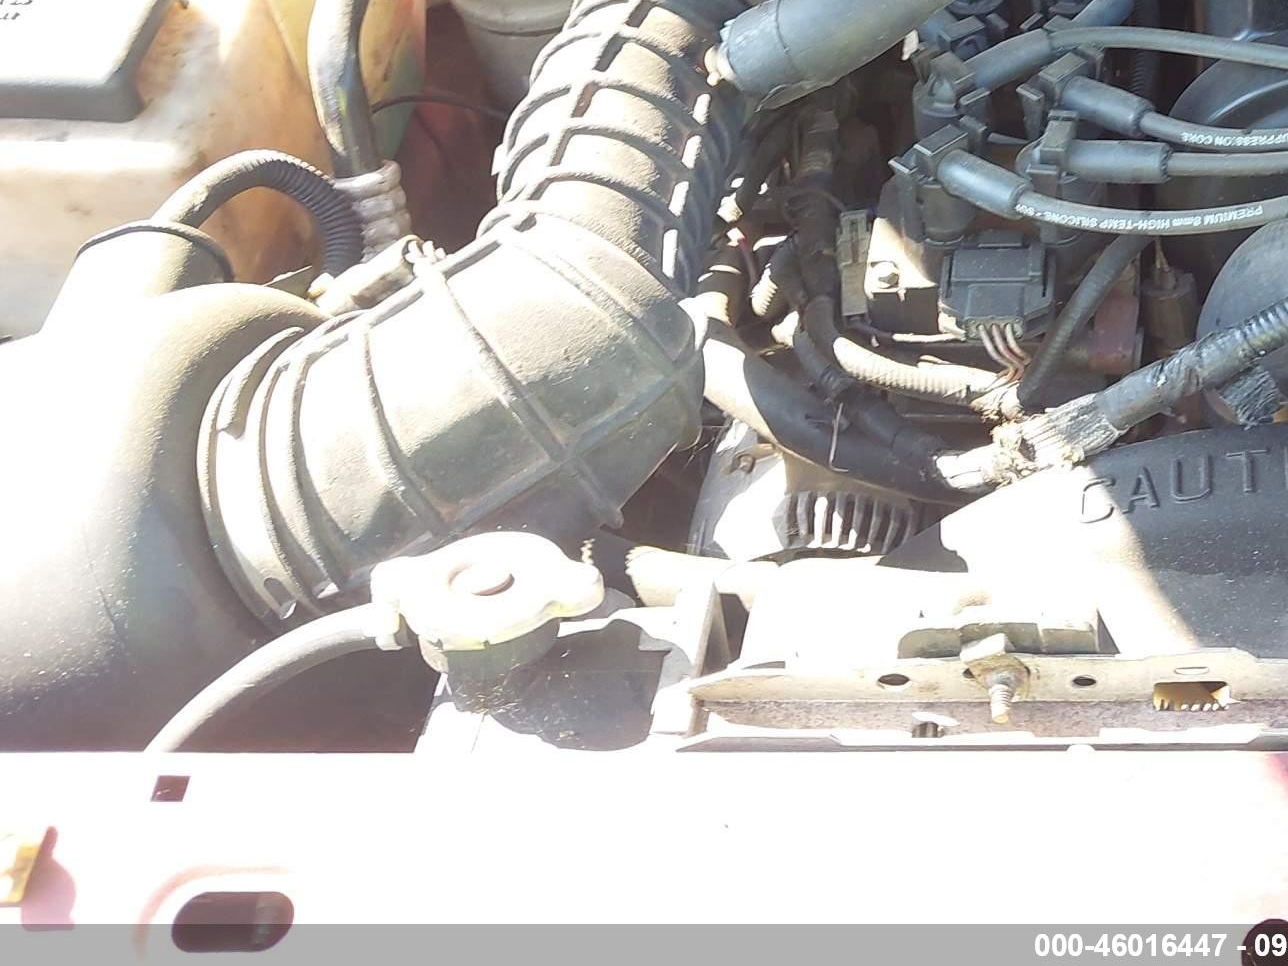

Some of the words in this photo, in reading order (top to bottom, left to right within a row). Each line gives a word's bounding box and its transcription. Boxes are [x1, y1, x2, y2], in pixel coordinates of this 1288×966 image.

[1043, 211, 1098, 228] SILICONE
[1173, 216, 1202, 228] 8mm
[1203, 205, 1264, 226] PREMIUM
[1099, 218, 1170, 231] HIGH-TEMP
